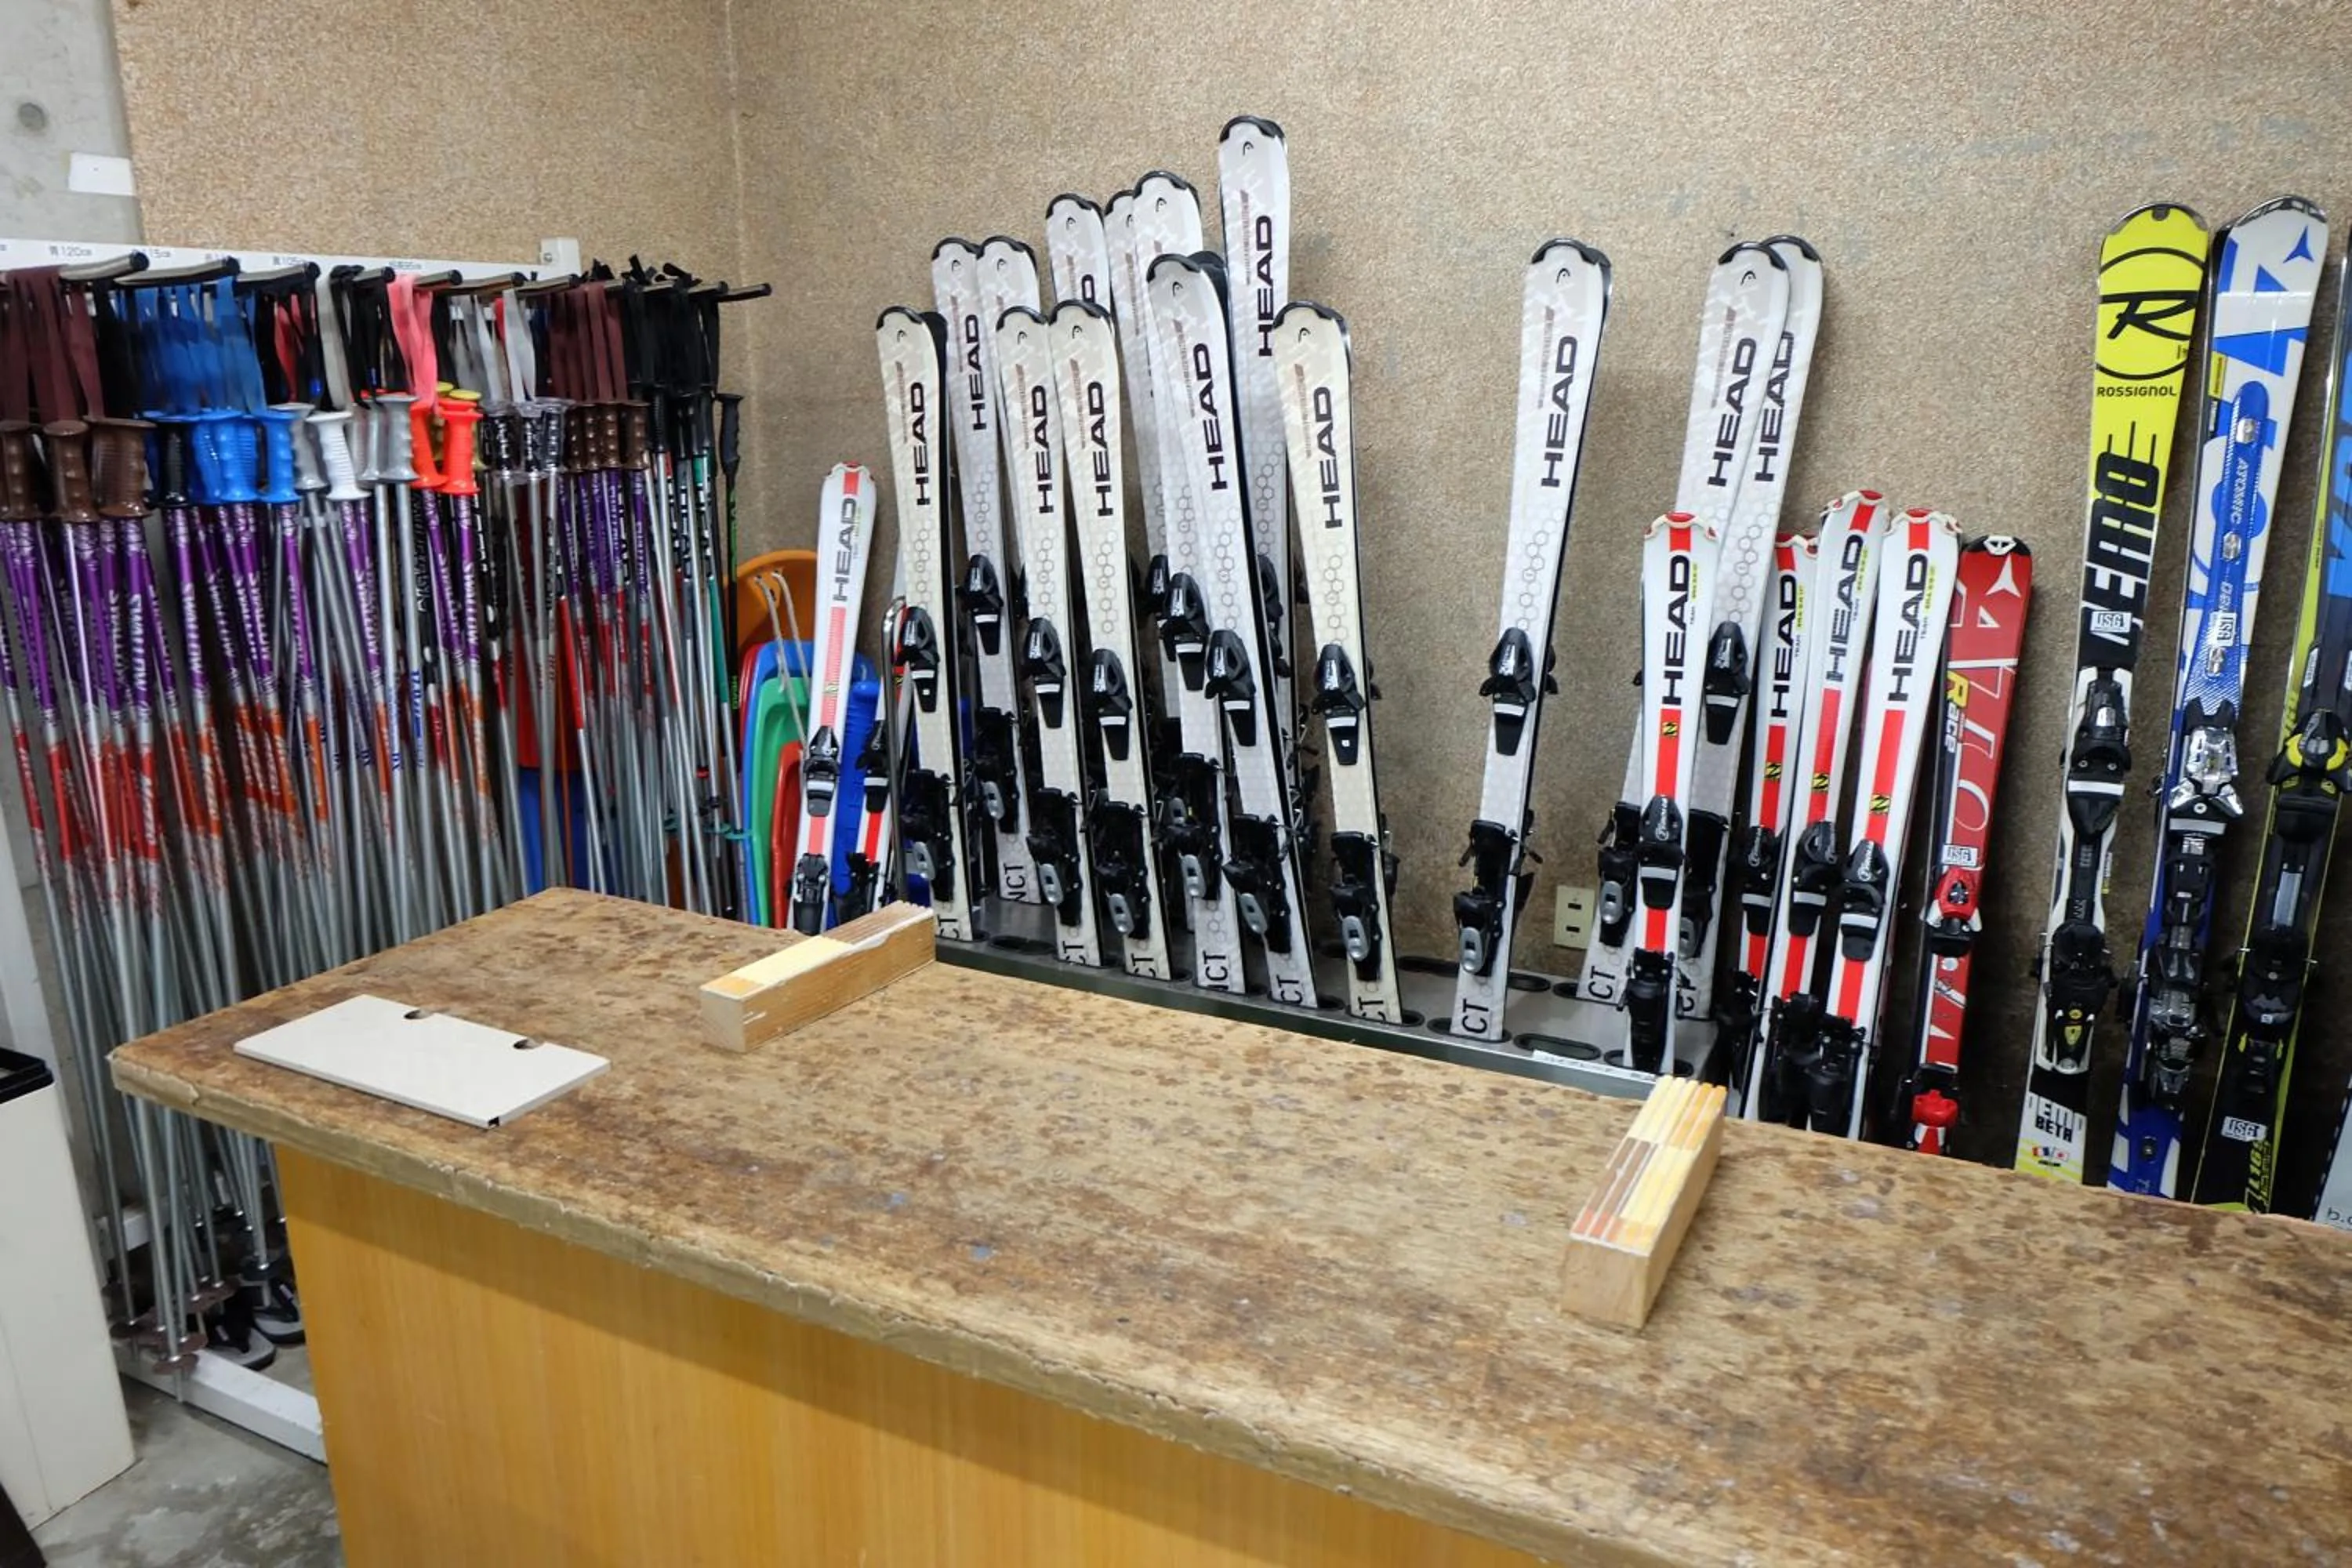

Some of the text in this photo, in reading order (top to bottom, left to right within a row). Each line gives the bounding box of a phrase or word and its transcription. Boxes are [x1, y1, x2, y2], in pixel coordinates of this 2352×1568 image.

[1256, 216, 1274, 357] HEAD
[965, 314, 986, 431] HEAD
[1193, 343, 1227, 490] HEAD
[1541, 336, 1577, 488] HEAD
[1708, 338, 1756, 488] HEAD
[1755, 331, 1794, 481] HEAD
[2096, 386, 2177, 397] ROSSIGNOL
[910, 382, 930, 506] HEAD
[1032, 386, 1054, 514] HEAD
[1087, 382, 1113, 516] HEAD
[1314, 387, 1342, 528] HEAD
[2230, 457, 2249, 525] ATOMIC
[833, 498, 857, 602] HEAD
[1826, 535, 1864, 683] HEAD
[1662, 554, 1690, 706] HEAD
[1771, 575, 1796, 718] HEAD
[1888, 554, 1928, 702] HEAD
[1944, 670, 1969, 753] Race
[1462, 998, 1489, 1033] CT
[1588, 966, 1616, 1000] CT
[2035, 1115, 2073, 1143] BETA
